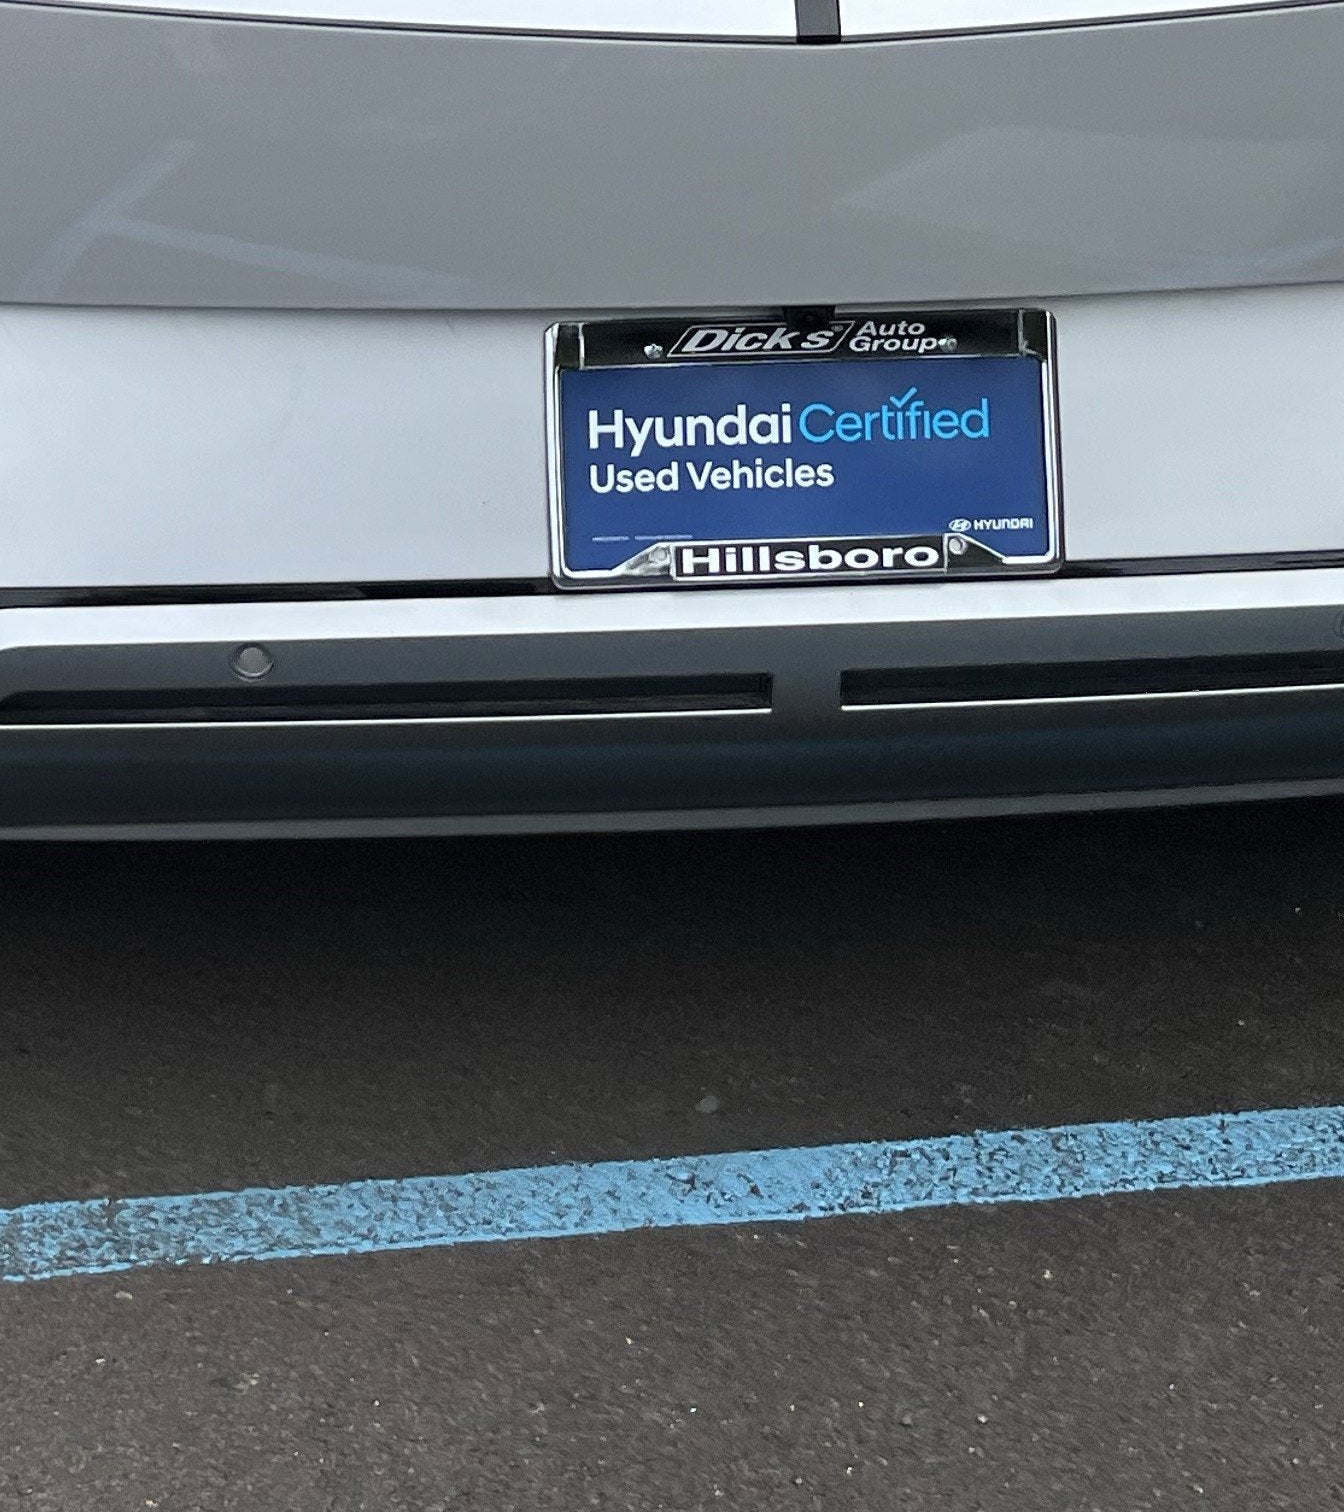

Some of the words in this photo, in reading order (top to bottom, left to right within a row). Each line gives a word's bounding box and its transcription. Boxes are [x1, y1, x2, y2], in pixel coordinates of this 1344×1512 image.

[681, 326, 835, 353] Dicks
[856, 320, 926, 336] Auto
[849, 337, 938, 354] Group
[588, 403, 792, 457] Hyundai
[799, 388, 990, 444] Certified
[589, 462, 680, 494] Used
[686, 458, 835, 490] Vehicles
[974, 517, 1034, 530] HYUNDAI
[682, 544, 940, 575] Hillsboro
